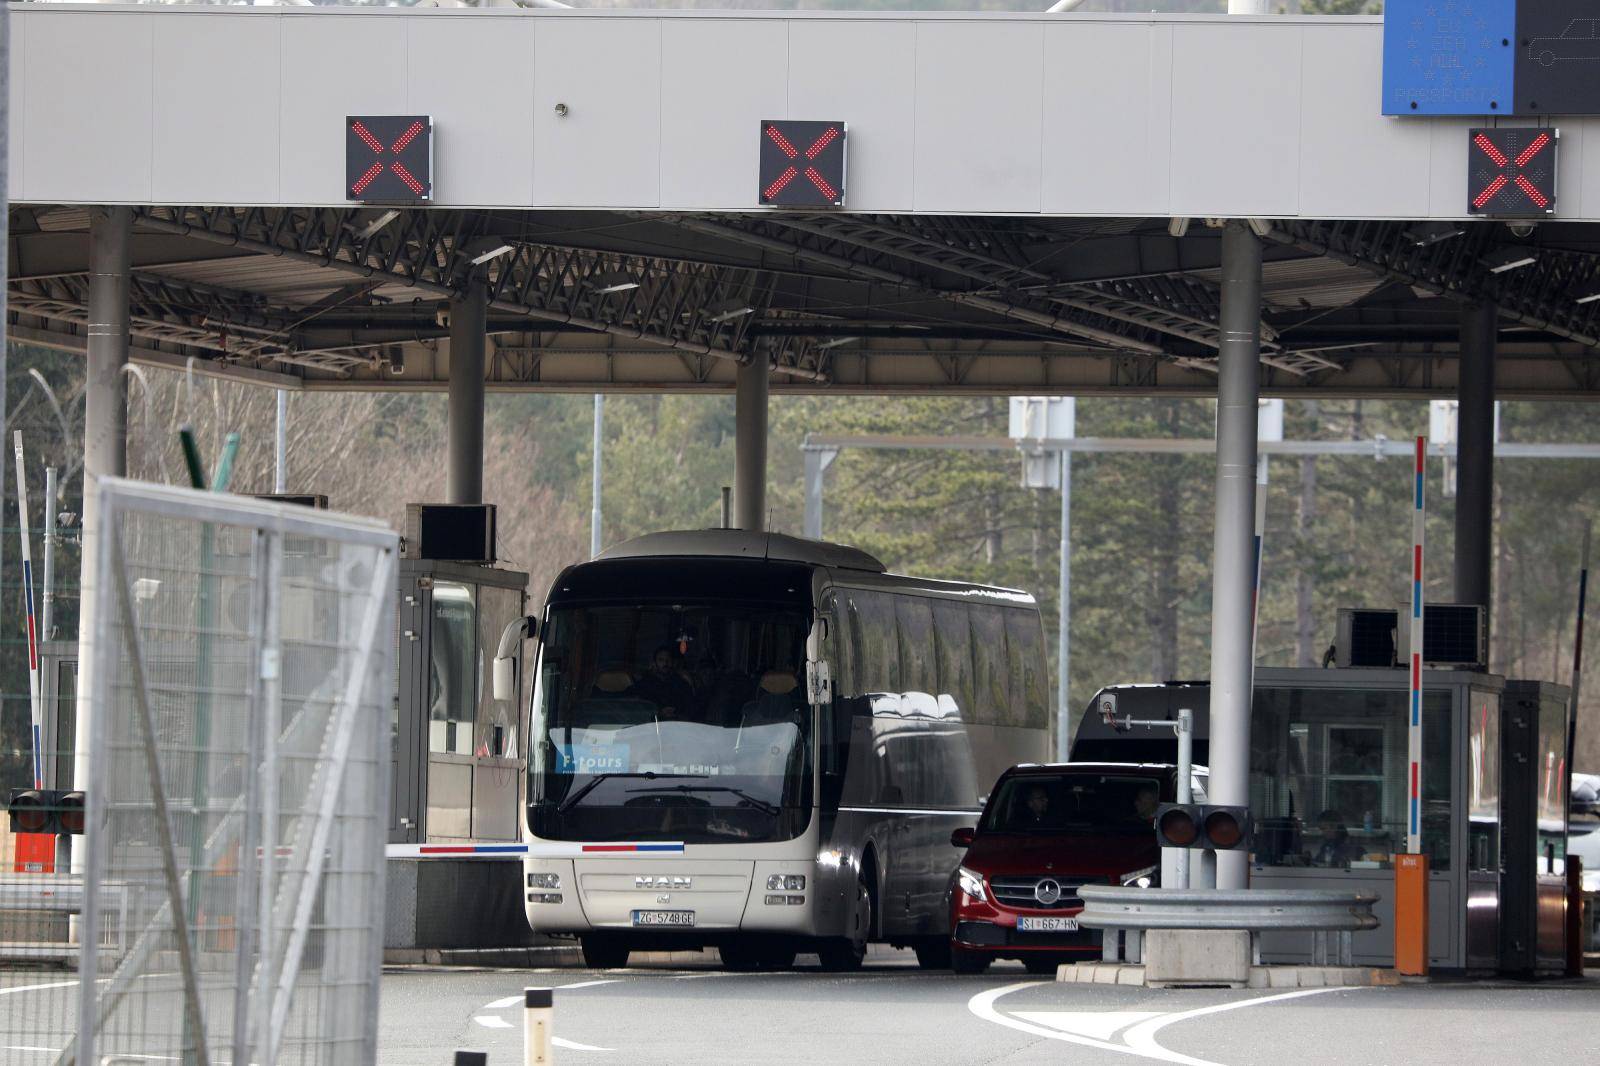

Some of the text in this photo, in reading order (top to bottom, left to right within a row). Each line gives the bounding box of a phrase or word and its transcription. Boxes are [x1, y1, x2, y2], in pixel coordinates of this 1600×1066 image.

[563, 755, 622, 769] F-tours
[635, 876, 692, 889] MAN
[640, 912, 652, 923] ZG
[1024, 918, 1034, 929] SI
